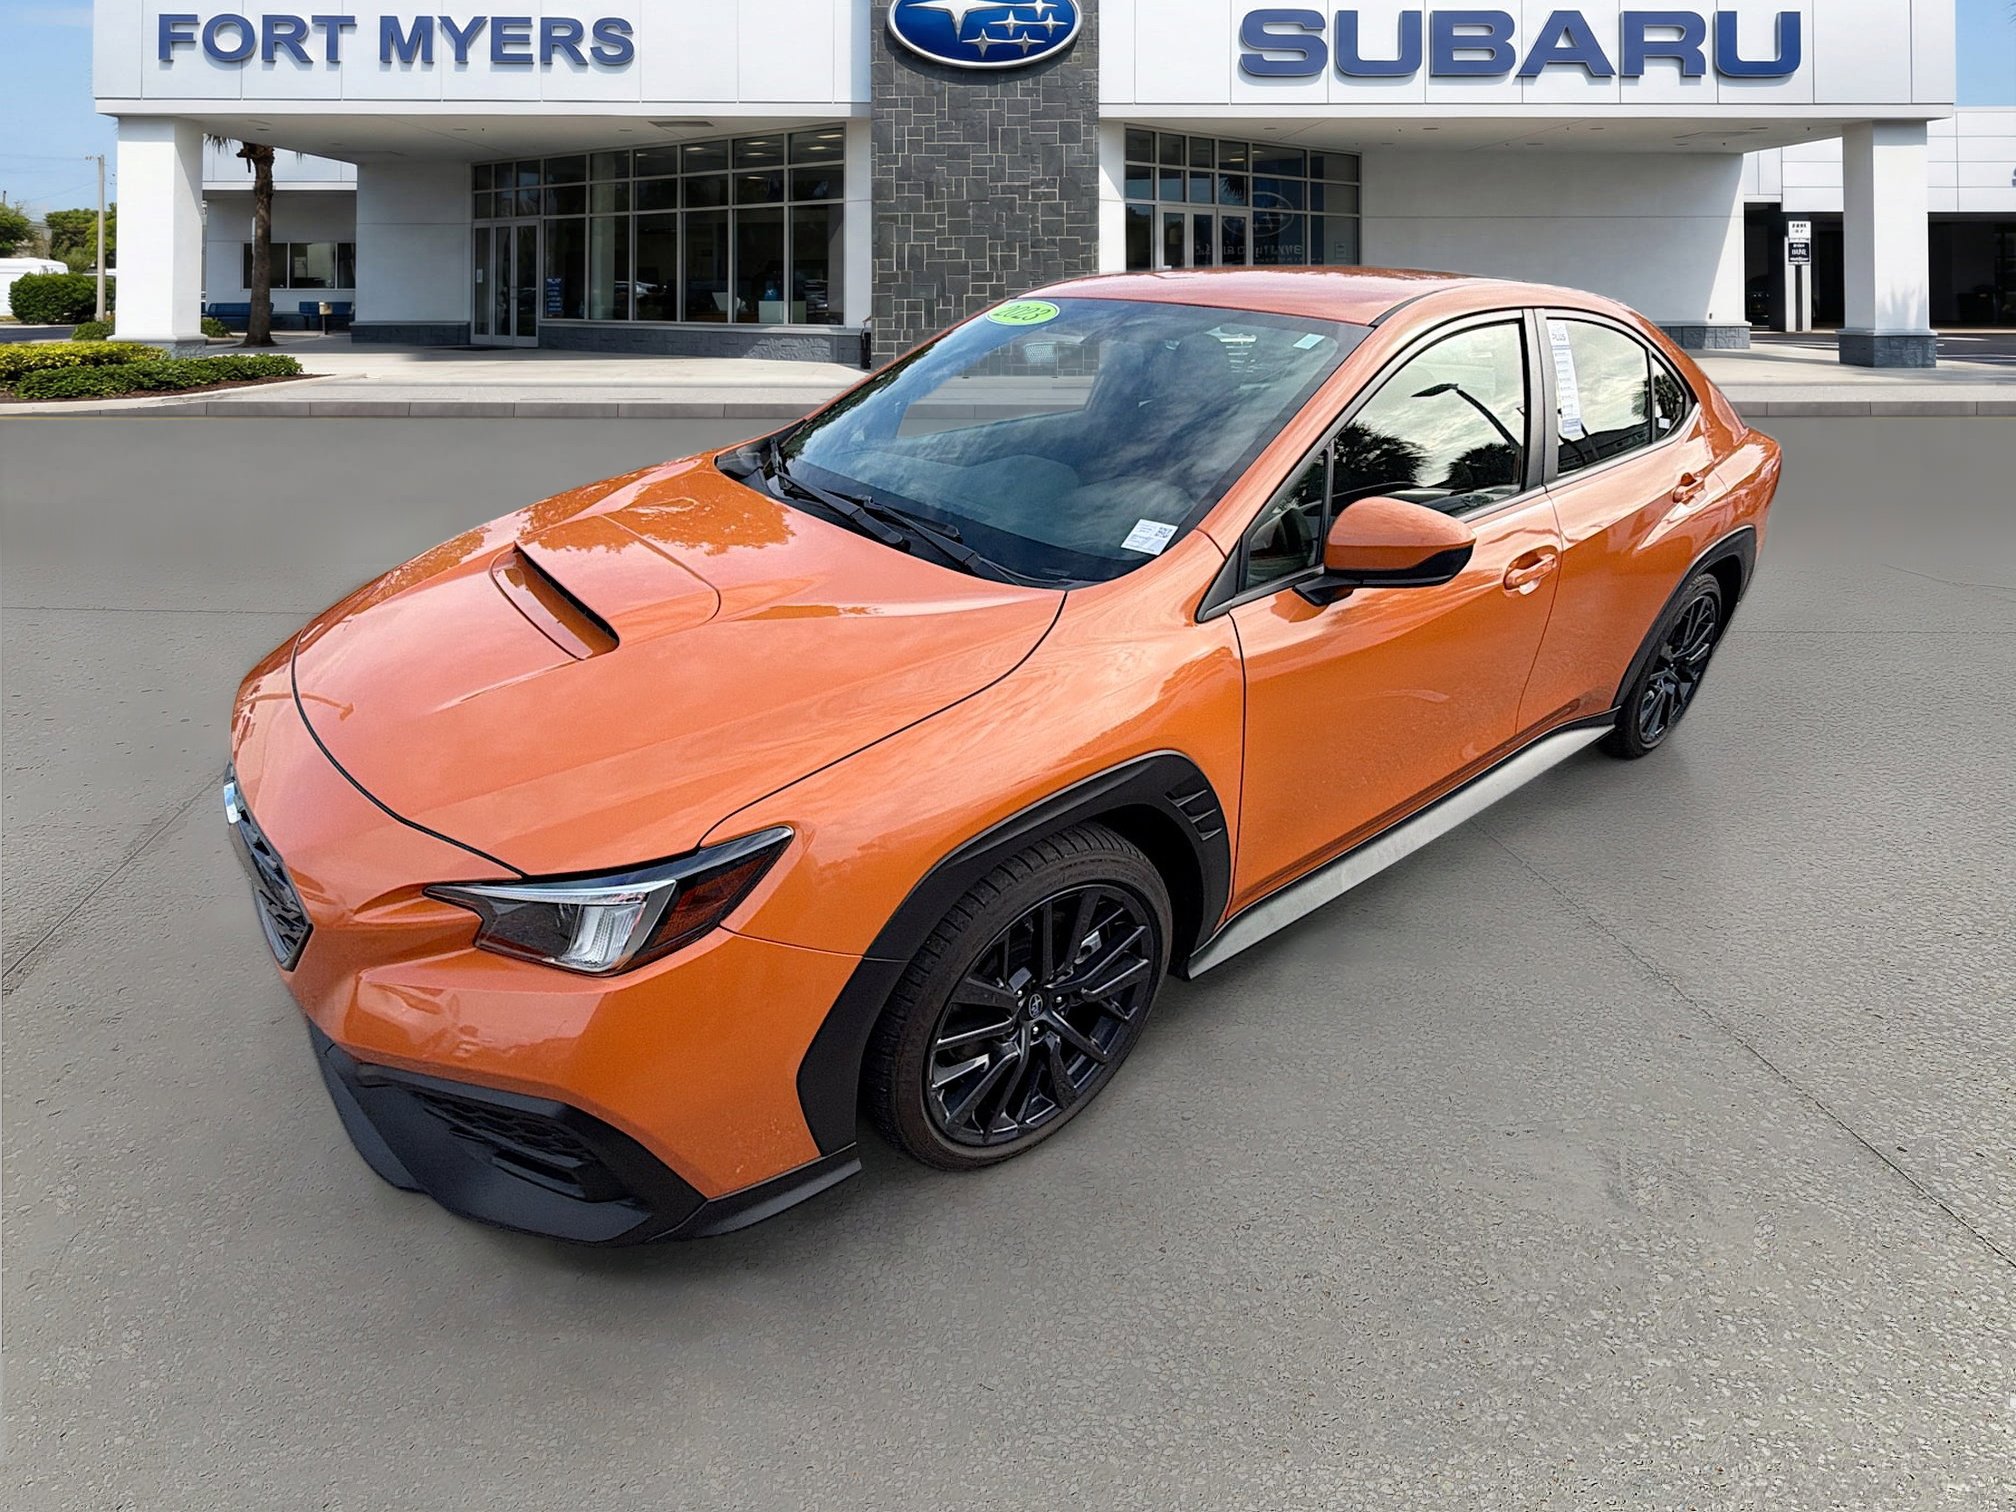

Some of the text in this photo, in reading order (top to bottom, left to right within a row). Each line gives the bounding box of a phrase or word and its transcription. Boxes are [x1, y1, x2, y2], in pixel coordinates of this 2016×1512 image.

[158, 14, 634, 64] FORT MYERS
[1240, 8, 1802, 77] SUBARU
[993, 305, 1051, 320] 2023
